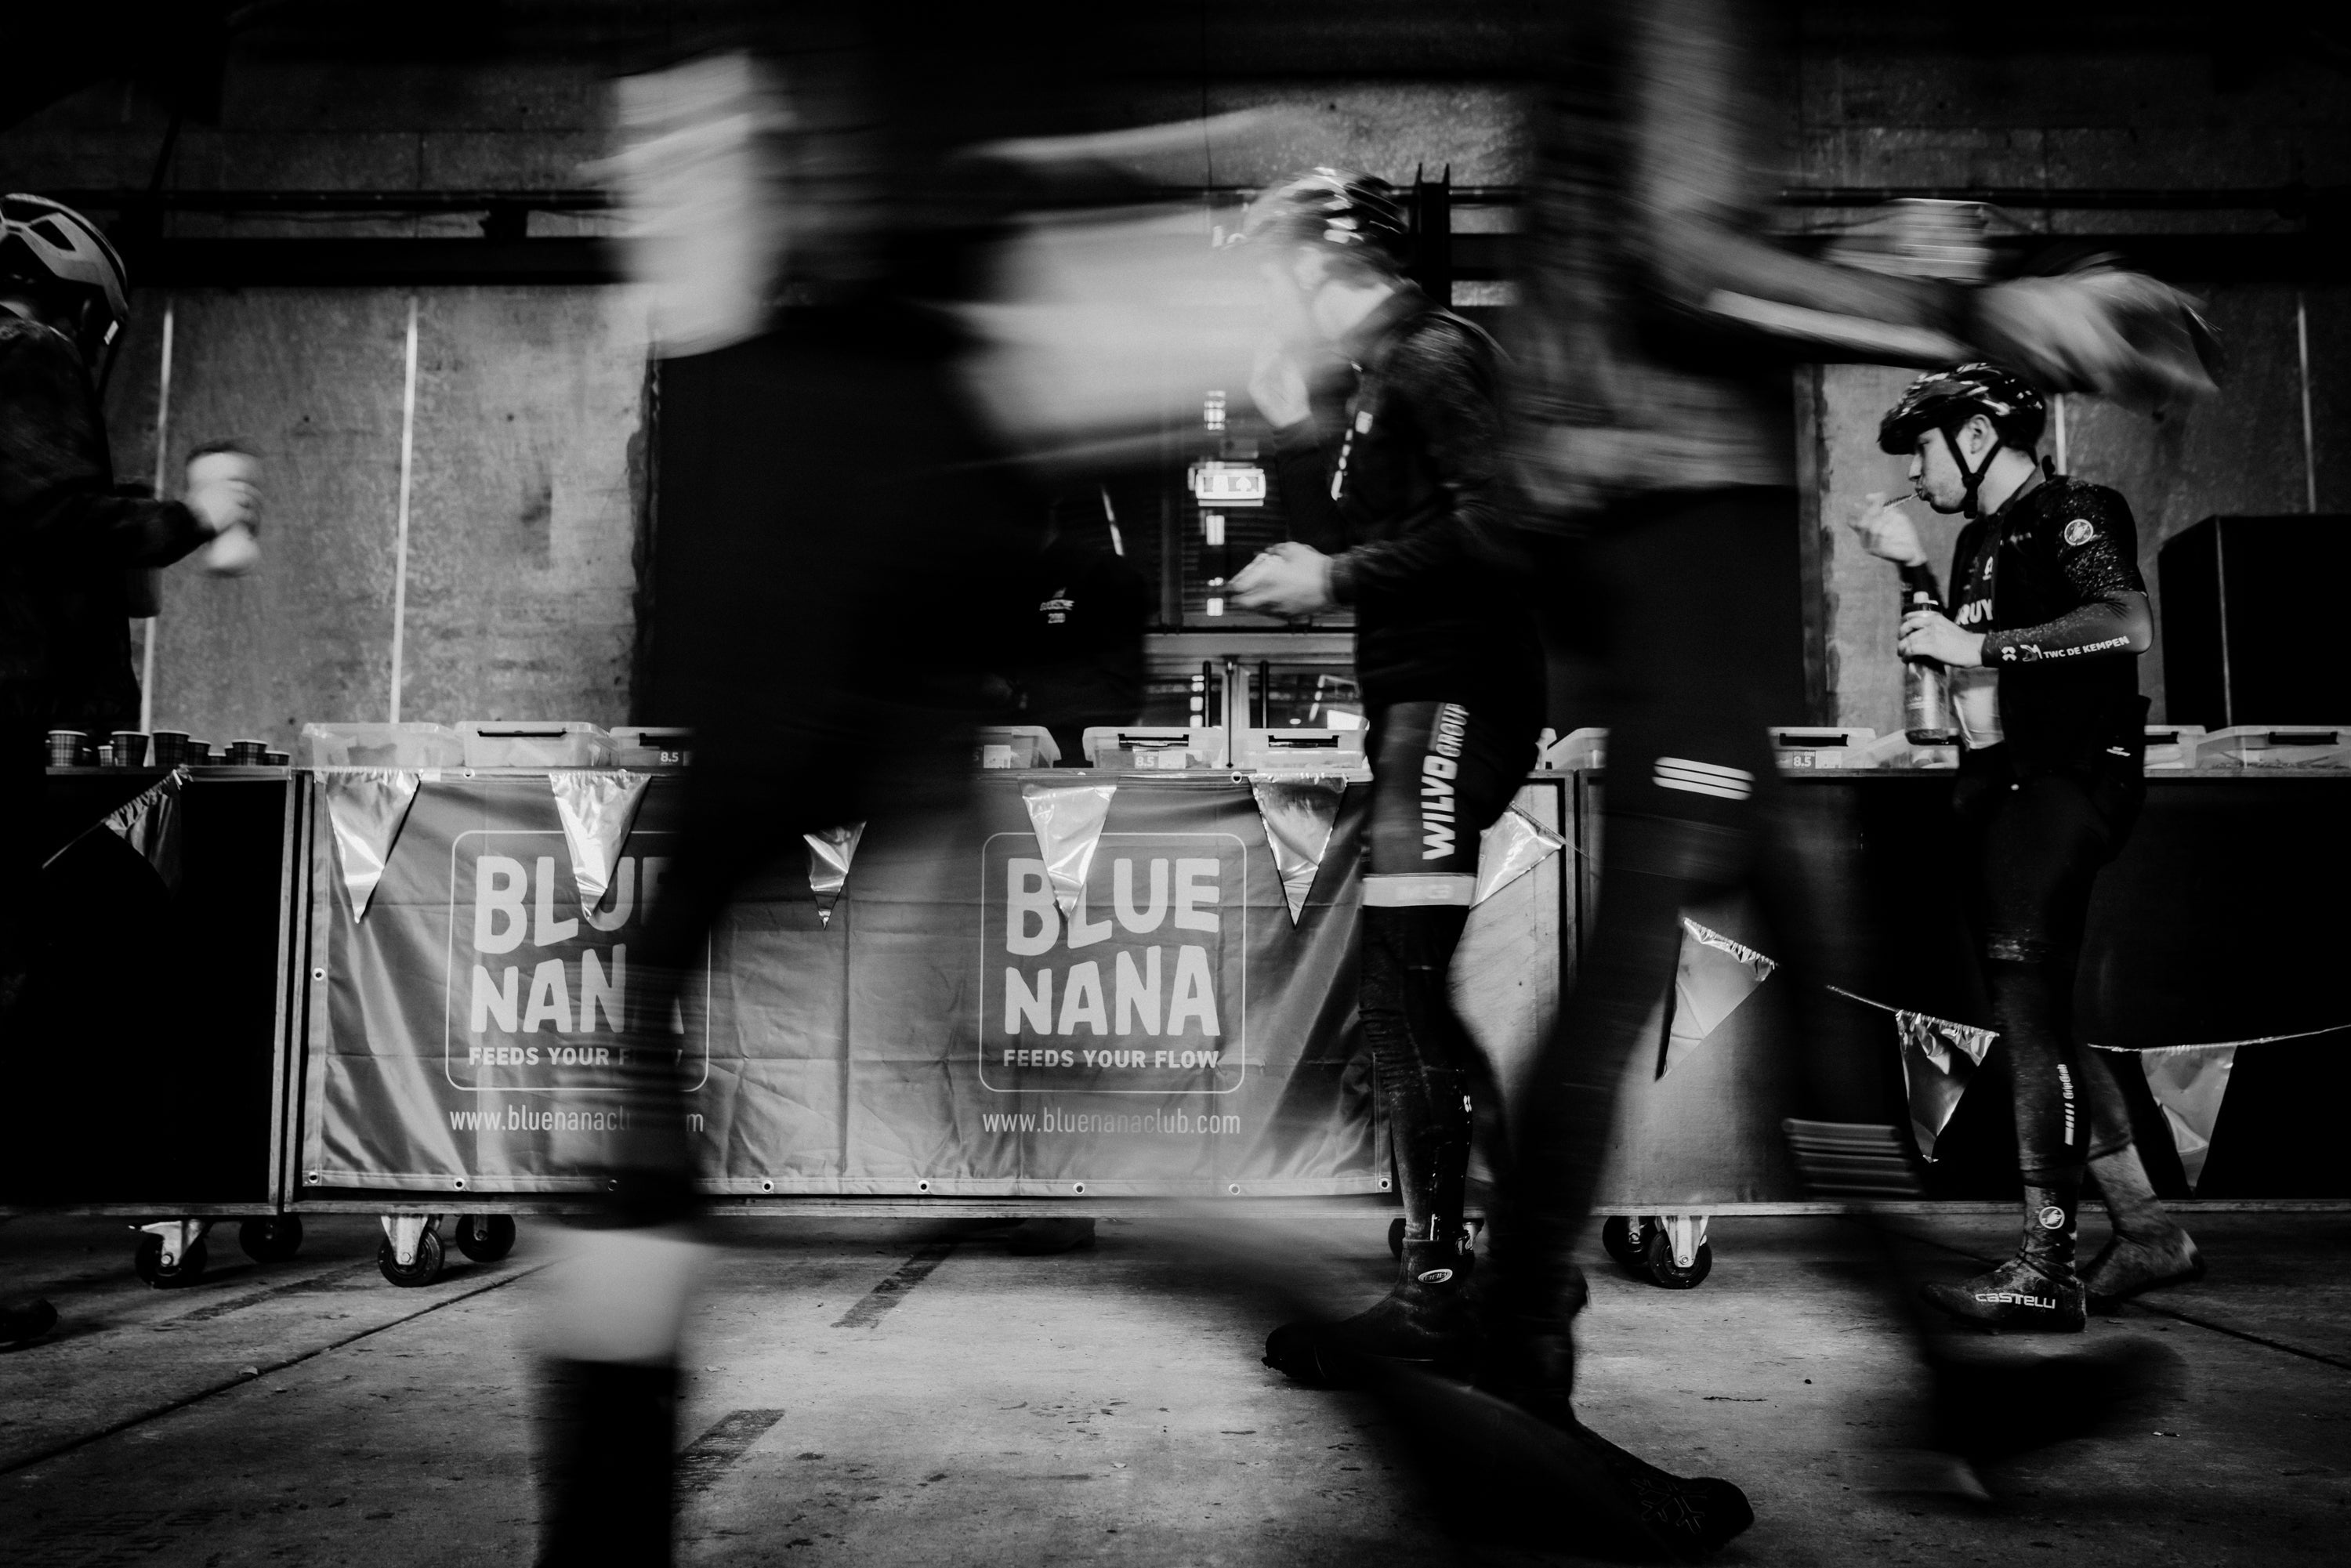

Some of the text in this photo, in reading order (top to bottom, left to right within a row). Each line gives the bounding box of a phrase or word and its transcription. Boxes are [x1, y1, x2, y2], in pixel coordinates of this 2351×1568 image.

[2043, 636, 2130, 659] TWC DE KEMPEN
[660, 751, 679, 762] 8.5
[1136, 756, 1155, 767] 8.5
[1793, 756, 1811, 766] 8.5
[1420, 755, 1458, 860] WILVO
[1006, 857, 1220, 956] BLUE
[471, 943, 685, 1034] NAN
[1005, 944, 1221, 1036] NANA
[469, 1047, 539, 1066] FEEDS
[548, 1047, 610, 1066] YOUR
[1003, 1049, 1219, 1069] FEEDS YOUR FLOW
[982, 1106, 1241, 1135] www.bluenanaclub.com
